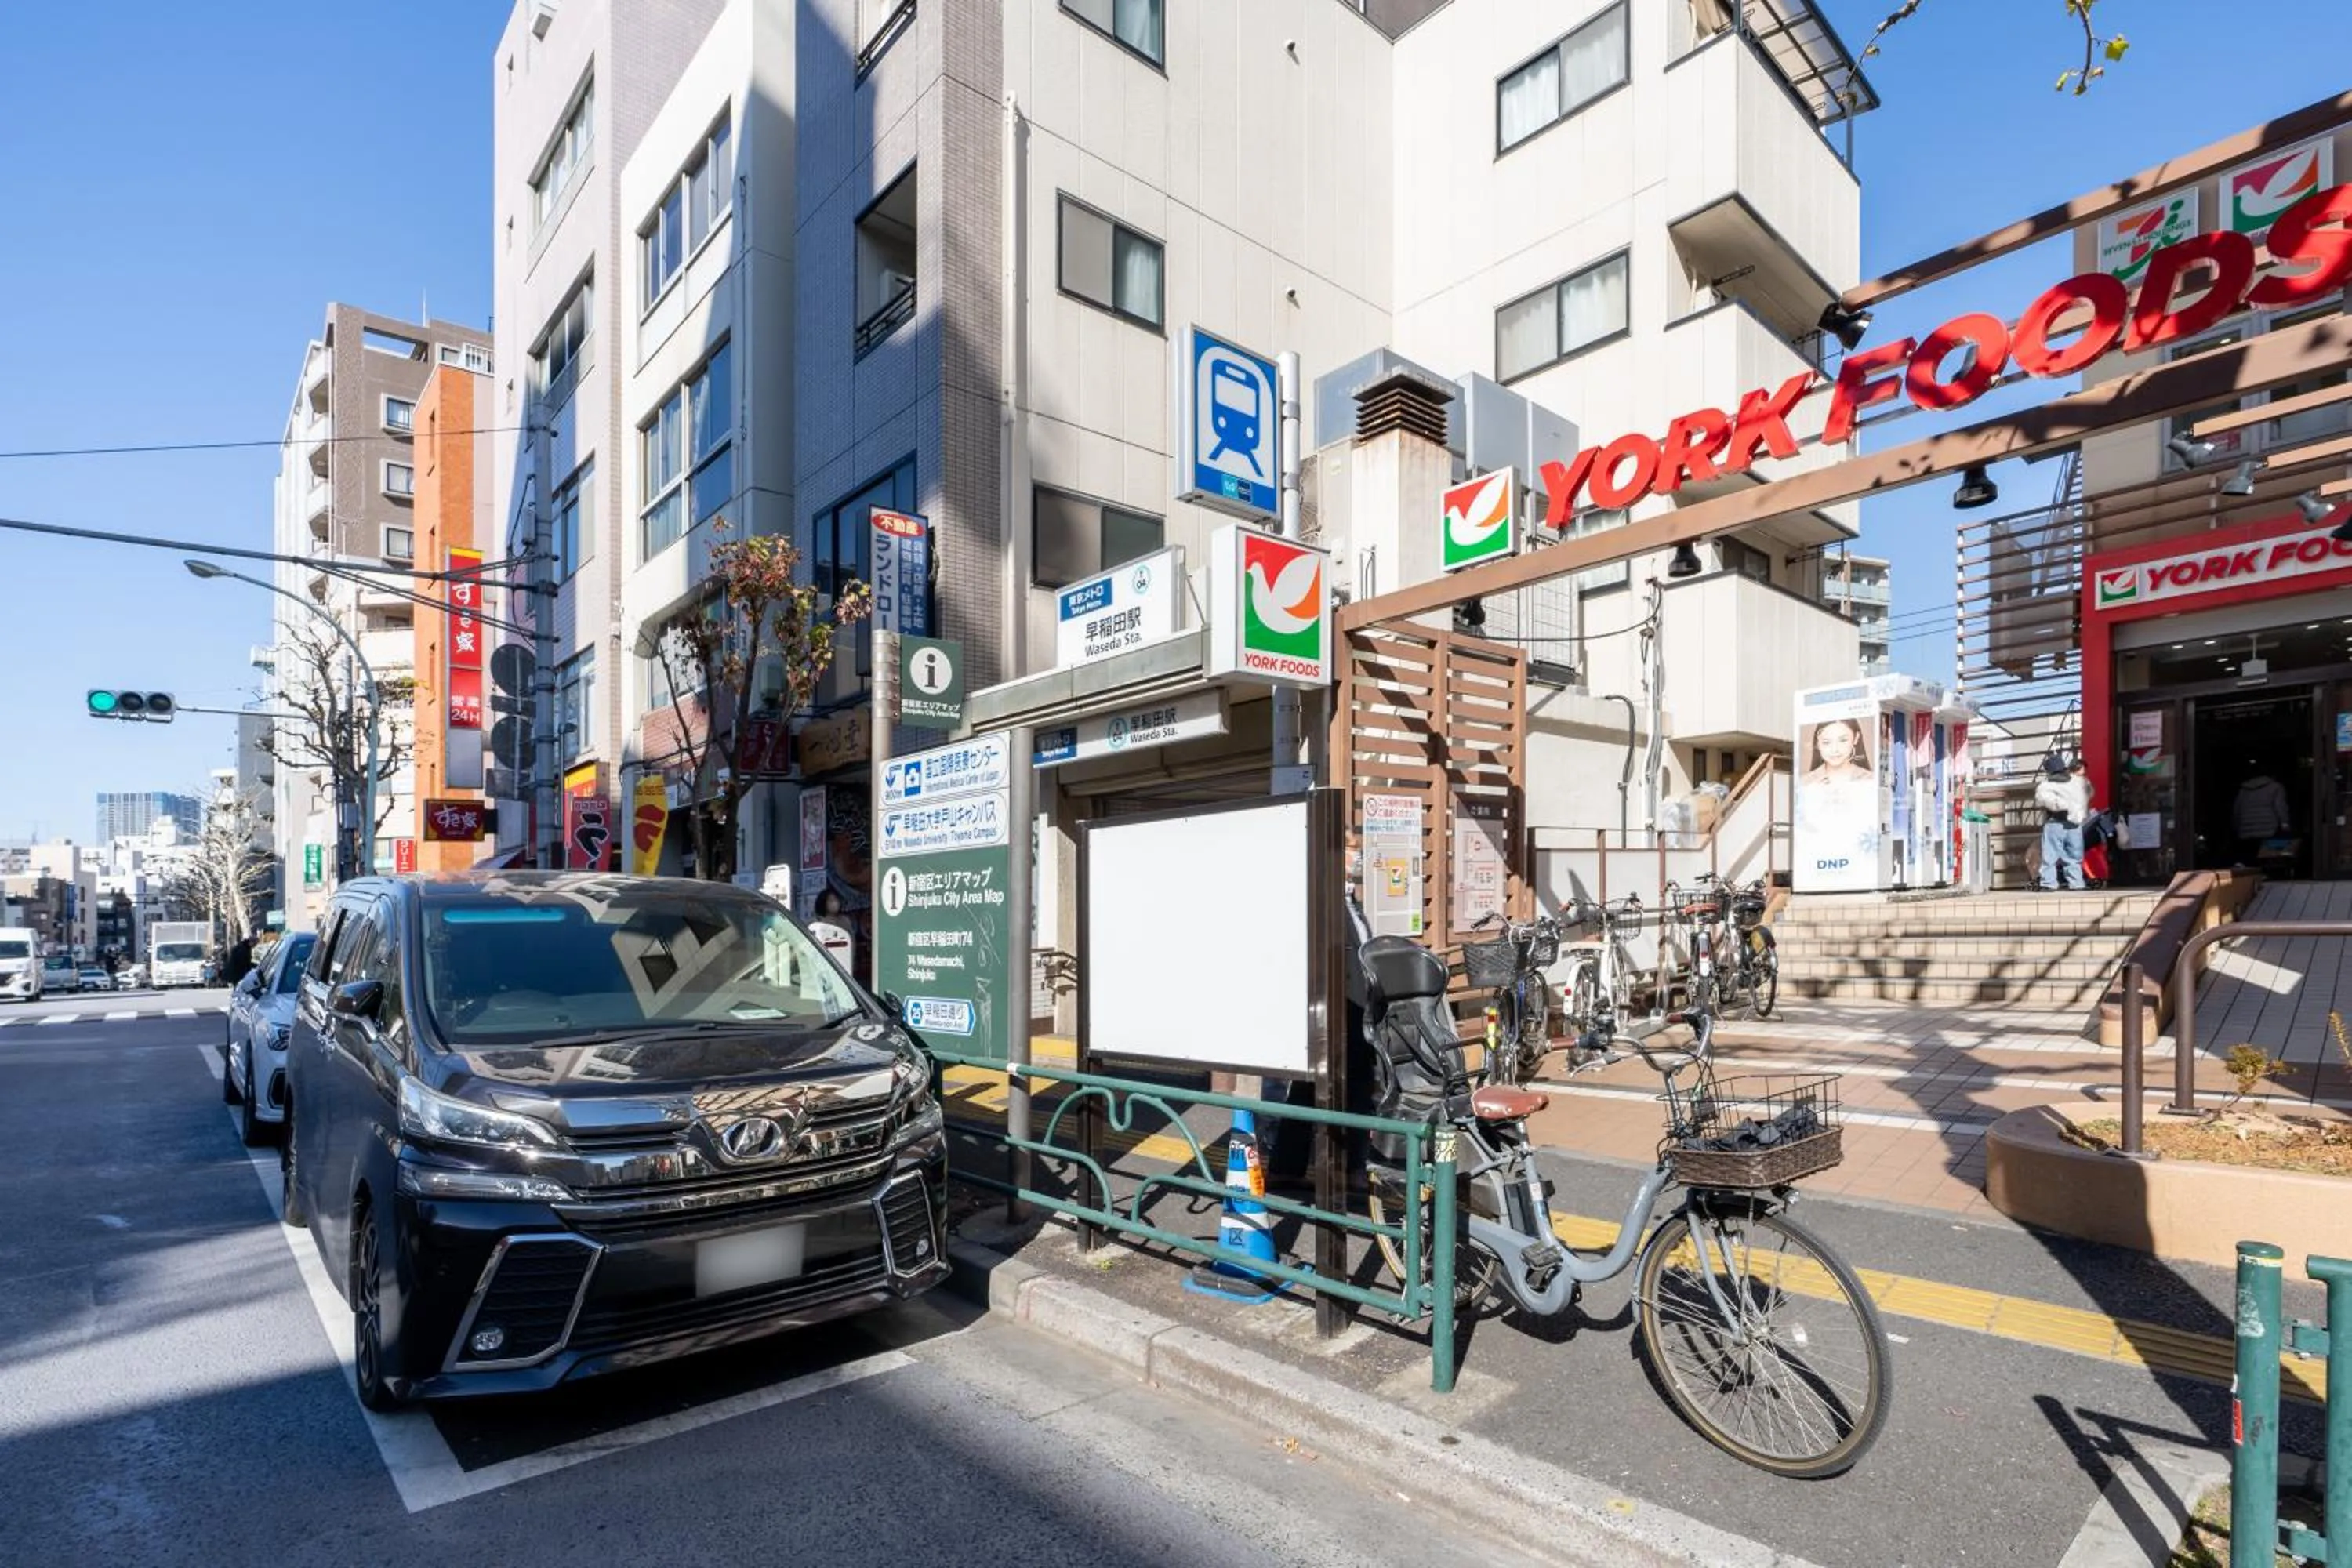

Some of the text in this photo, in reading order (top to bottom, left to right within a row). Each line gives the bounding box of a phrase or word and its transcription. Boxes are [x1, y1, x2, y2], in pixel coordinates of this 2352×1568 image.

[1540, 183, 2352, 528] YORK FOODS
[880, 515, 919, 536] 不動産
[2147, 547, 2262, 591] YORK
[876, 534, 891, 630] ランドロー
[1069, 585, 1104, 607] 東京メトロ
[1085, 607, 1142, 642] 早稲田駅
[1085, 632, 1142, 658] Waseda Sta.
[1244, 653, 1321, 678] YORK FOODS
[451, 709, 481, 721] 24H
[1131, 708, 1178, 731] 早稲田駅
[1131, 728, 1178, 744] Waseda Sta.
[434, 804, 477, 830] すき家
[904, 801, 996, 831] 早稲田大学戸山キャンパス
[1817, 858, 1849, 869] DNP
[908, 866, 993, 891] 新宿区エリアマップ
[908, 889, 1004, 909] Shinjuku City Area Map
[908, 931, 973, 947] 新宿区早稲田町74
[907, 968, 936, 982] Shinjuku
